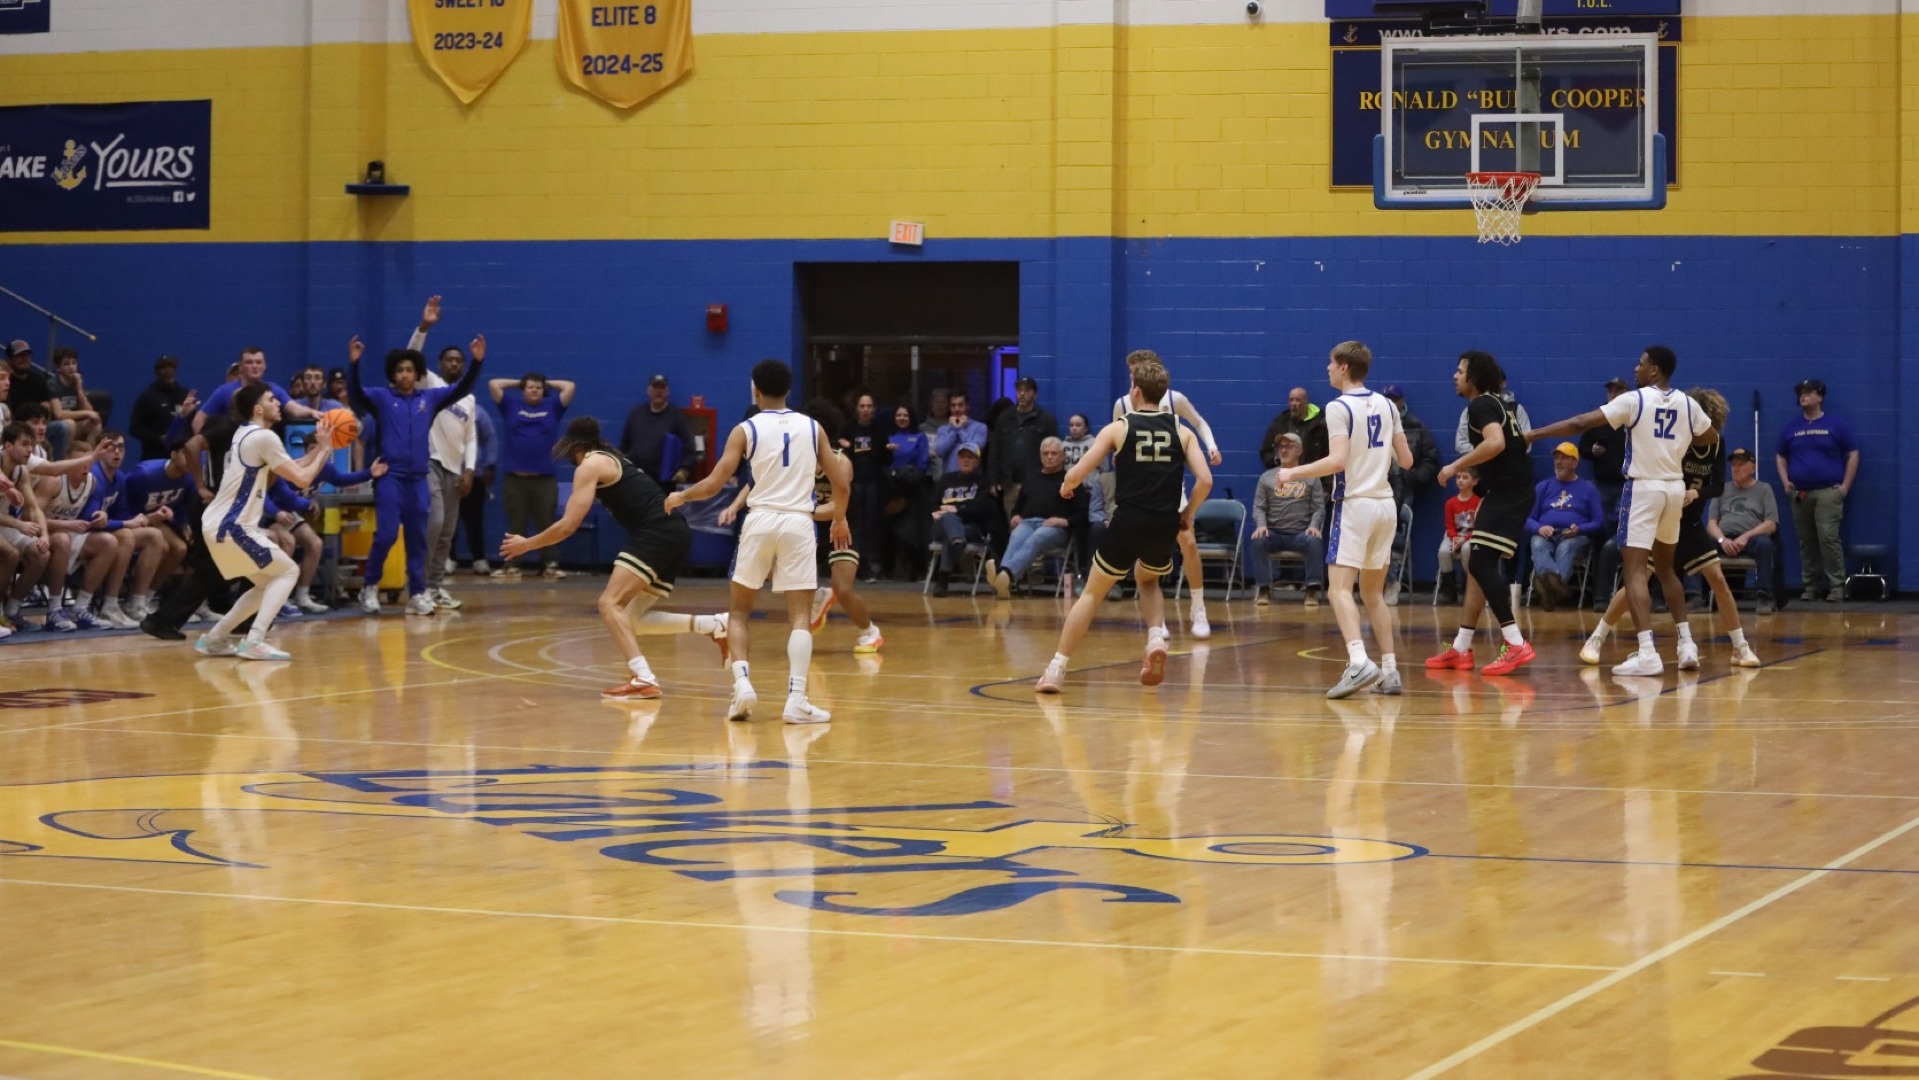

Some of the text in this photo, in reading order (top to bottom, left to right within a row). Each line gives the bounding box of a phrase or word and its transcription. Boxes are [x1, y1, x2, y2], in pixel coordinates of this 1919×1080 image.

[592, 6, 656, 27] ELITE 8
[434, 33, 503, 50] 2023-24
[583, 54, 663, 75] 2024-25
[1424, 130, 1580, 149] GYMNAUM
[91, 133, 195, 191] YOURS
[896, 223, 918, 242] EXIT
[1367, 413, 1384, 449] 12
[1654, 408, 1678, 440] 52
[782, 432, 791, 467] 1
[1136, 430, 1171, 461] 22
